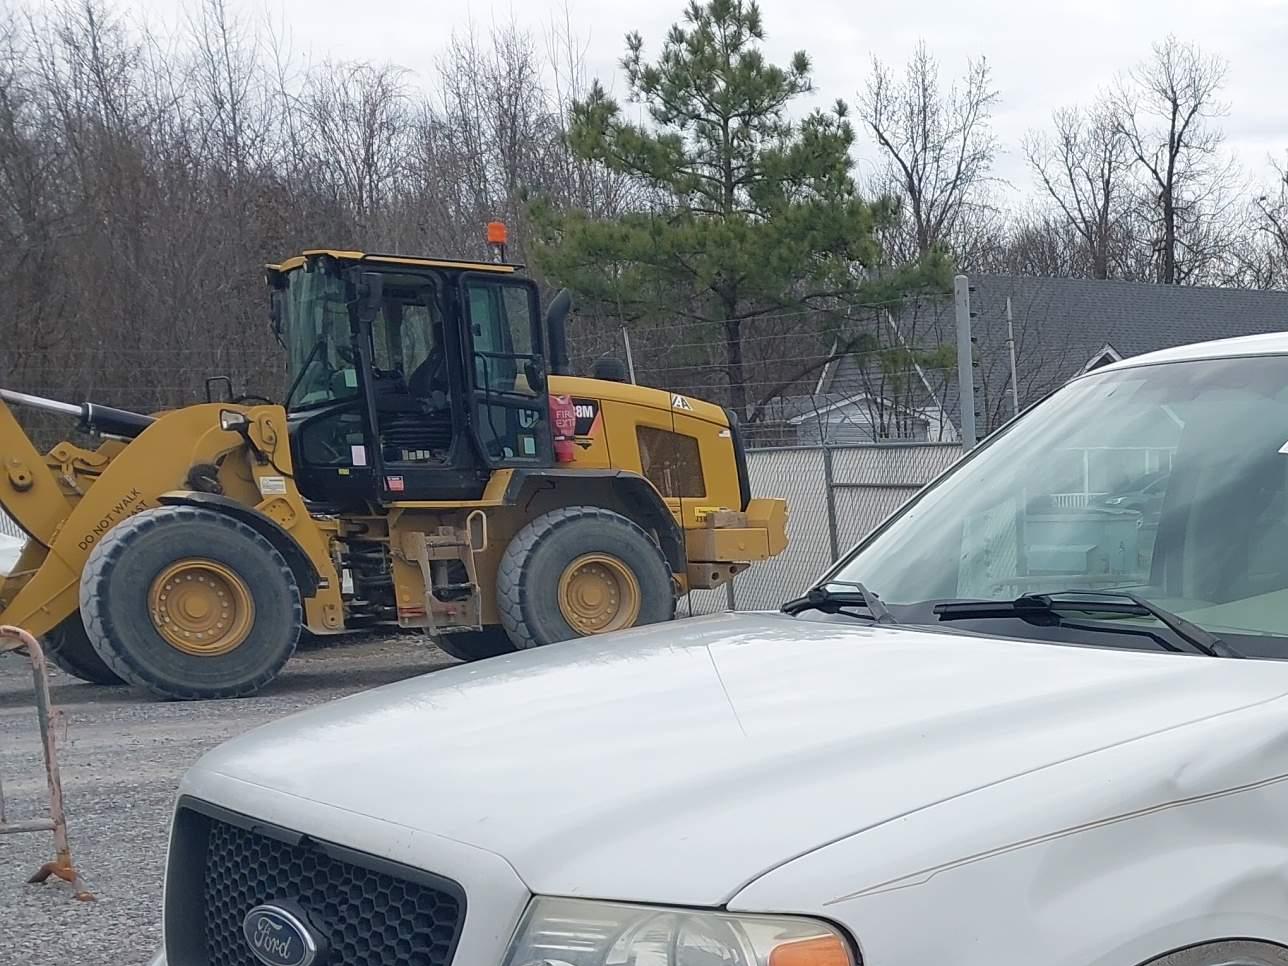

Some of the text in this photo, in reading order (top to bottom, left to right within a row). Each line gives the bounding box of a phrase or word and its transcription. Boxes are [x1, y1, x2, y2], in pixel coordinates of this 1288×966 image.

[556, 410, 573, 419] FIR
[78, 487, 141, 551] DO NOT WALK
[254, 916, 292, 959] Ford
